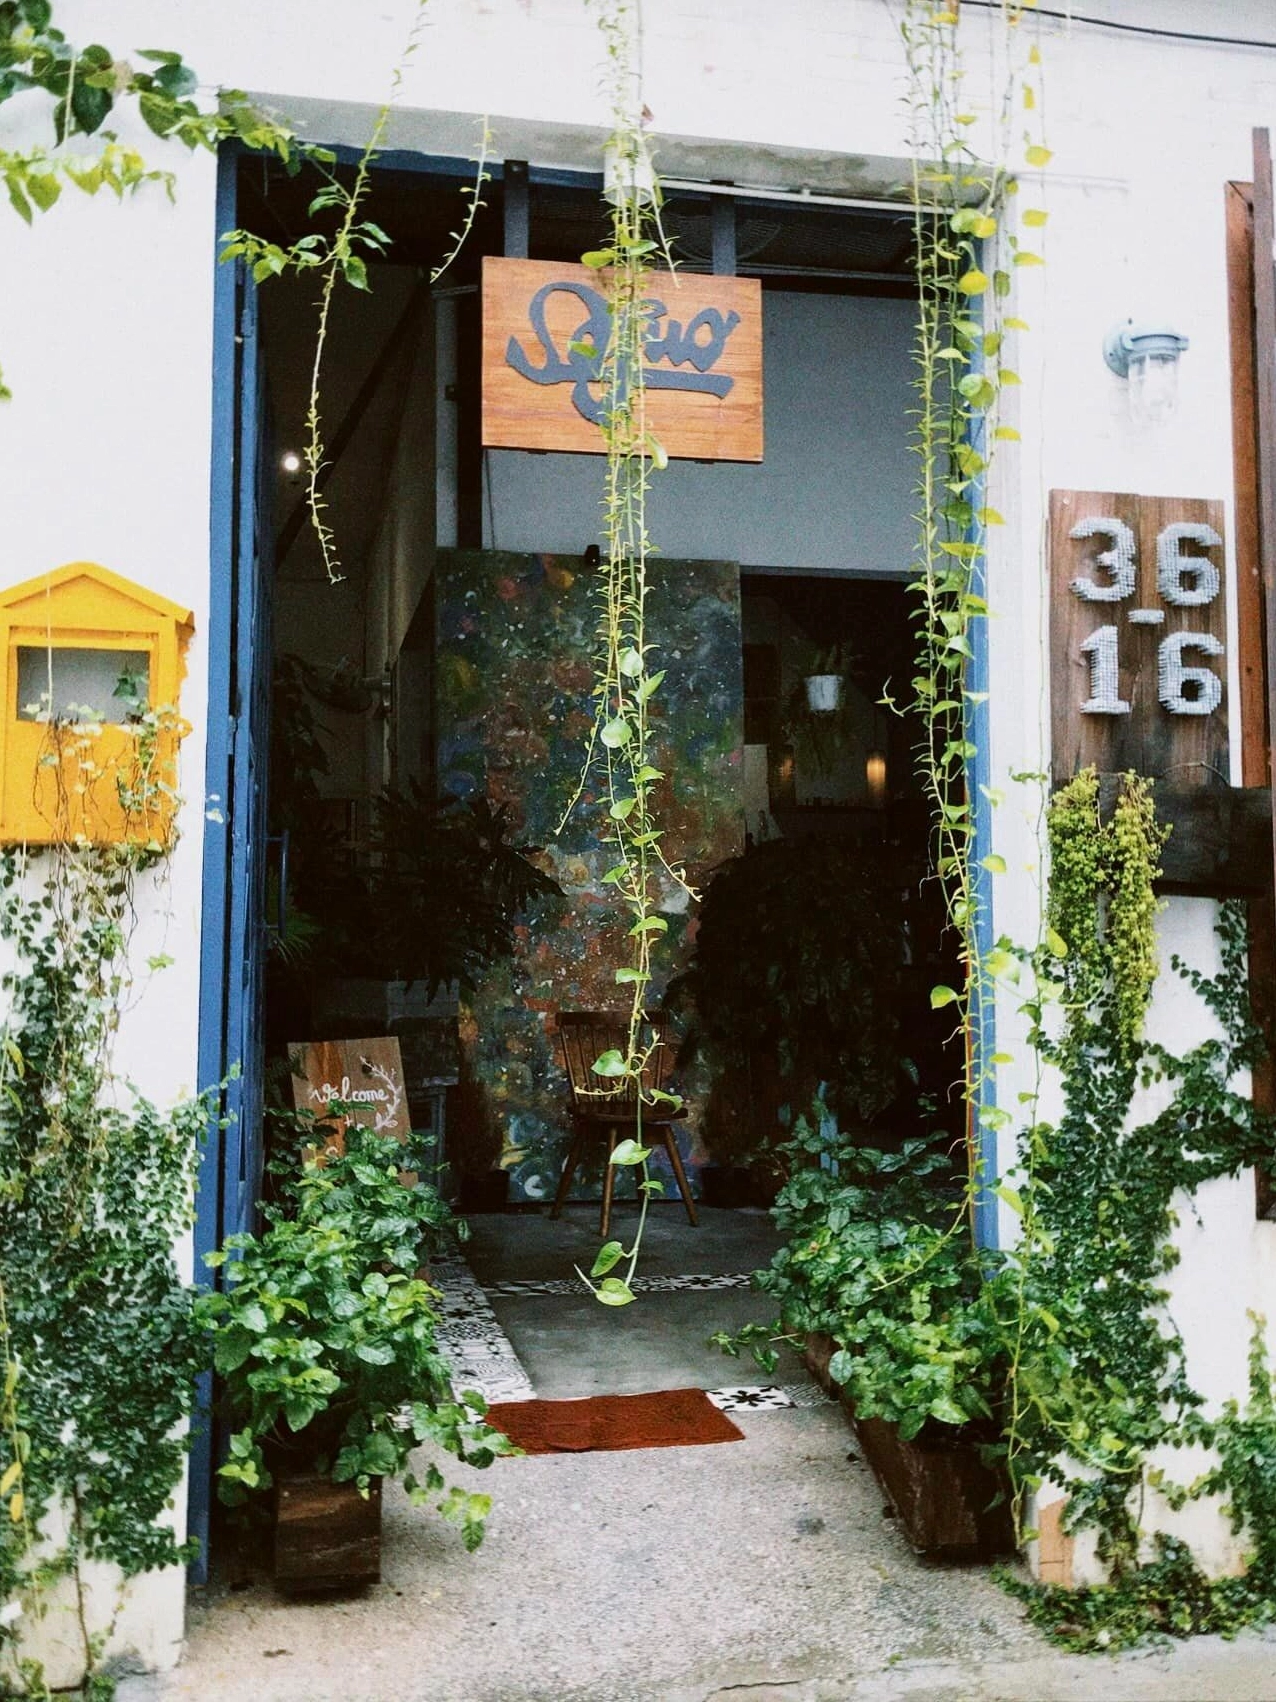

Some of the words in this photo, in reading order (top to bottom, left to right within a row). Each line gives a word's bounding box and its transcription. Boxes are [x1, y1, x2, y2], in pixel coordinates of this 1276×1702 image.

[1069, 517, 1222, 606] 36
[1080, 625, 1225, 715] 16
[309, 1076, 389, 1103] Welcome
